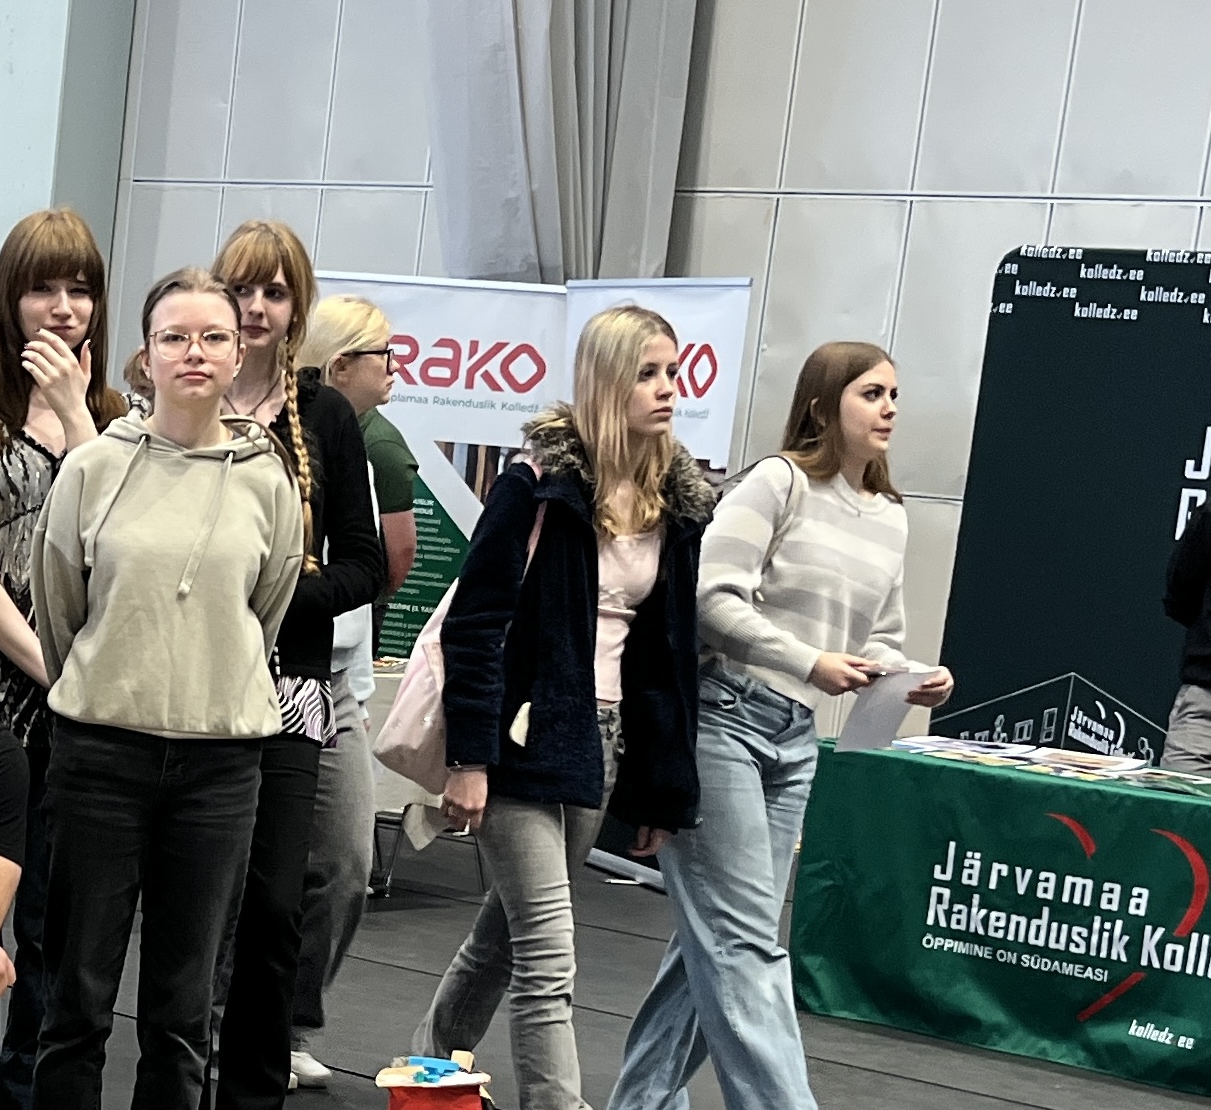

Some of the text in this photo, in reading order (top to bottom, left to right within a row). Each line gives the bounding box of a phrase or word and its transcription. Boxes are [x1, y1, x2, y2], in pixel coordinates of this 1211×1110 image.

[933, 840, 1150, 917] Järvamaa
[922, 933, 1109, 982] ÕPPIMINE ON SÜDAMEASI
[926, 886, 1211, 979] Rakenduslik Koll
